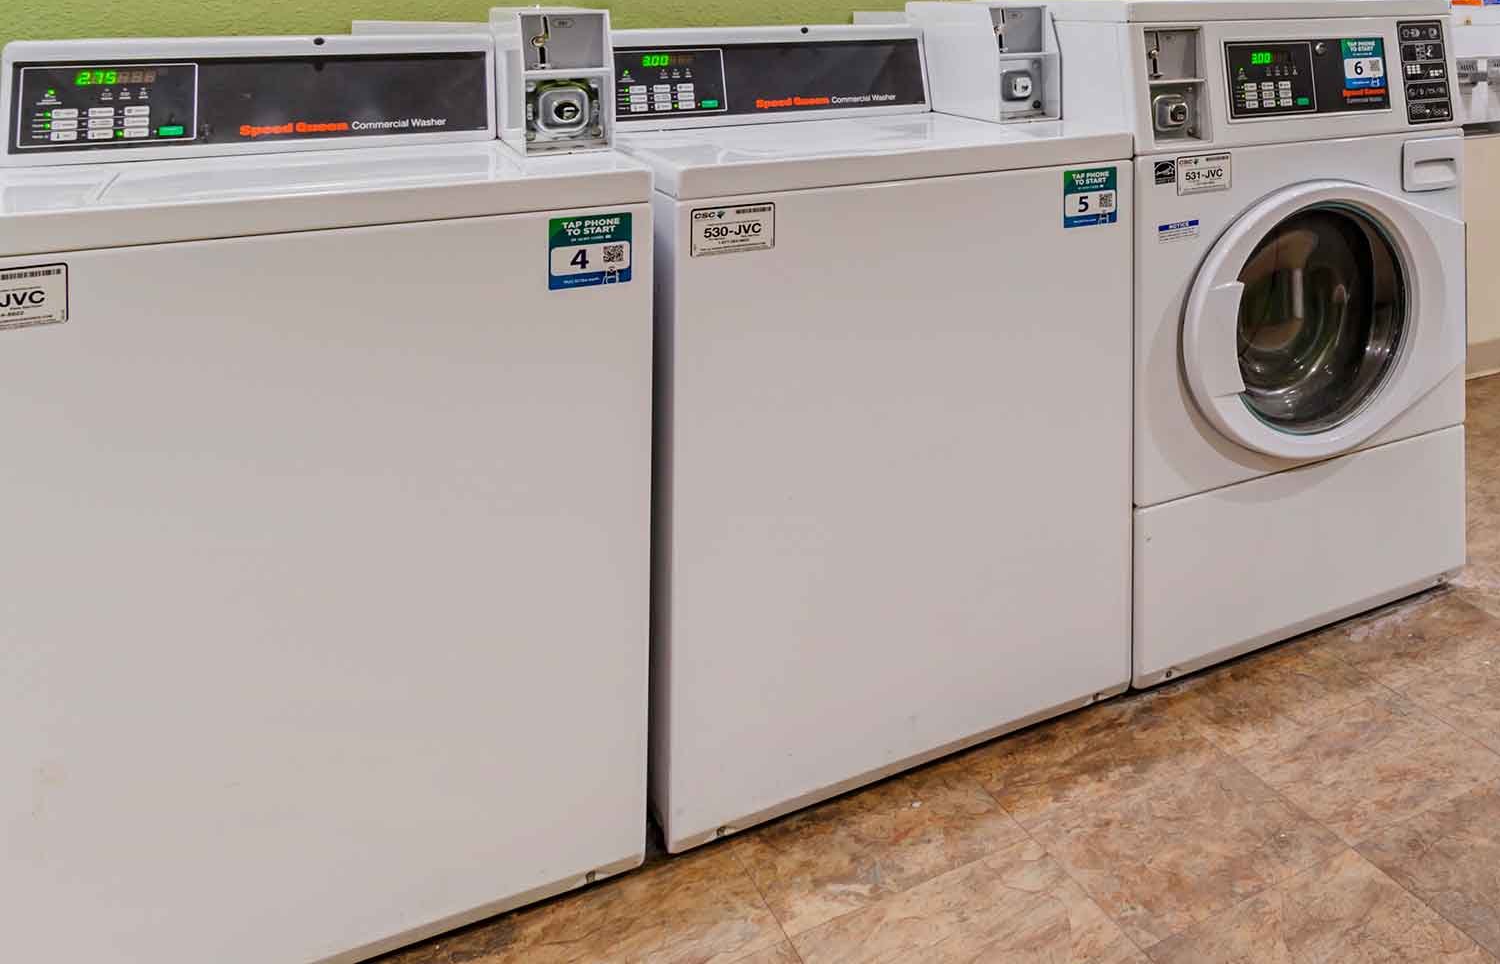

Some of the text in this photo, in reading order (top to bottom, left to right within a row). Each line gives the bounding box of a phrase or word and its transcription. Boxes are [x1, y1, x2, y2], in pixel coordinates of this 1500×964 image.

[1354, 61, 1363, 76] 6
[831, 95, 871, 104] Commercial
[872, 94, 896, 102] Washer
[351, 119, 408, 130] Commercial
[411, 117, 446, 128] Washer
[1085, 177, 1106, 185] START
[1185, 168, 1223, 181] 531-JVC
[1078, 196, 1089, 213] 5
[694, 211, 716, 220] CSC
[562, 218, 620, 229] TAP PHONE
[583, 225, 617, 235] START
[704, 223, 762, 239] 530-JVC
[570, 249, 589, 269] 4
